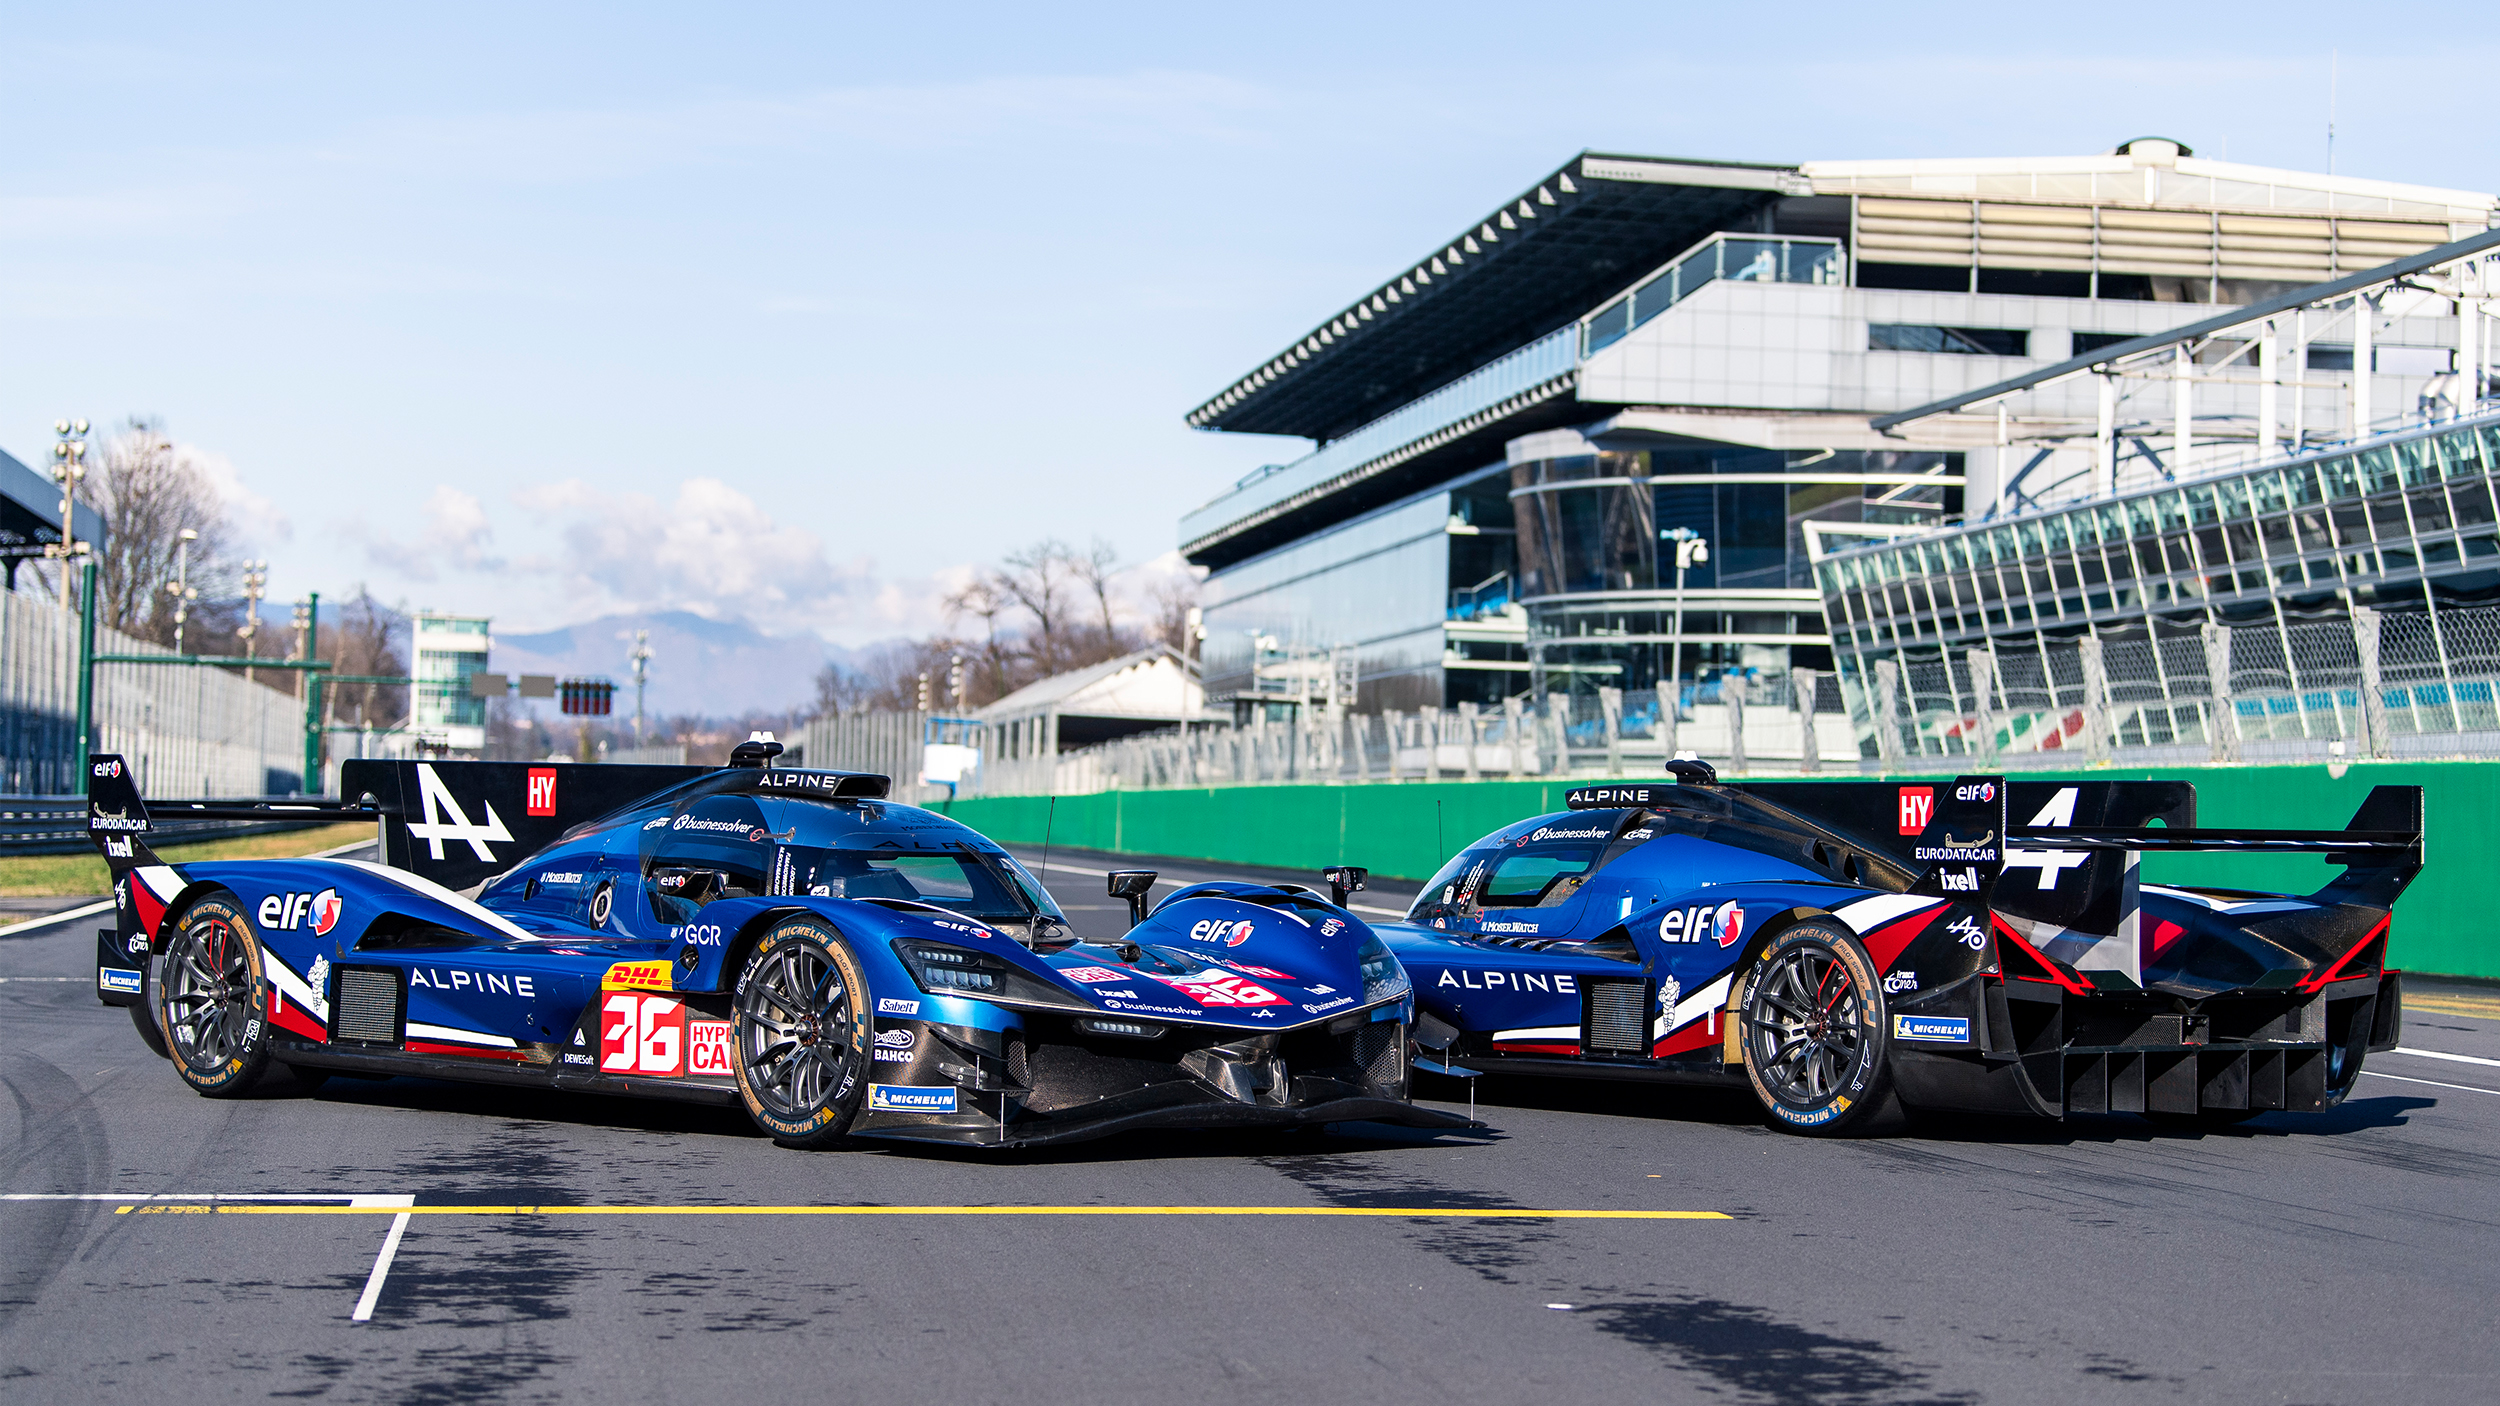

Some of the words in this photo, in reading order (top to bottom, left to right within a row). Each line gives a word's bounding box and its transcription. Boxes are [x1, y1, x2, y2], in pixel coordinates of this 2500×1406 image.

[94, 762, 111, 776] elf
[759, 773, 836, 788] ALPINE
[529, 776, 555, 808] HY
[1569, 789, 1650, 802] ALPINE
[1956, 784, 1981, 801] elf
[1901, 795, 1932, 827] HY
[92, 817, 147, 831] EURODATACAR
[686, 815, 754, 833] businessolver
[1544, 826, 1610, 840] businessolver
[106, 835, 133, 857] ixell
[1915, 847, 1995, 861] EURODATACAR
[660, 876, 677, 887] elf
[1939, 867, 1979, 890] ixell
[192, 904, 232, 919] MICHELIN
[258, 892, 313, 930] elf
[933, 920, 970, 932] elf
[1190, 919, 1234, 942] elf
[1659, 906, 1714, 942] elf
[238, 924, 249, 942] PILOT
[246, 941, 256, 962] SPORT
[685, 923, 721, 946] GCR
[777, 926, 828, 945] MICHELIN
[1780, 928, 1834, 946] MICHELIN
[1839, 944, 1853, 961] PILOT
[1851, 961, 1866, 984] SPORT
[110, 976, 140, 987] MICHELIN
[410, 967, 536, 997] ALPINE
[612, 966, 664, 985] DHL
[837, 953, 850, 971] PILOT
[846, 972, 857, 997] SPORT
[1438, 968, 1576, 994] ALPINE
[882, 1000, 914, 1013] Sabelt
[1122, 1001, 1203, 1016] businessolver
[602, 995, 683, 1072] 36
[1914, 1024, 1966, 1035] MICHELIN
[564, 1053, 594, 1066] DEWESoft
[693, 1043, 733, 1070] CA
[874, 1049, 914, 1063] BAHCO
[188, 1071, 227, 1085] MICHELIN
[890, 1094, 954, 1105] MICHELIN
[762, 1114, 813, 1133] MICHELIN
[1776, 1106, 1830, 1123] MICHELIN
